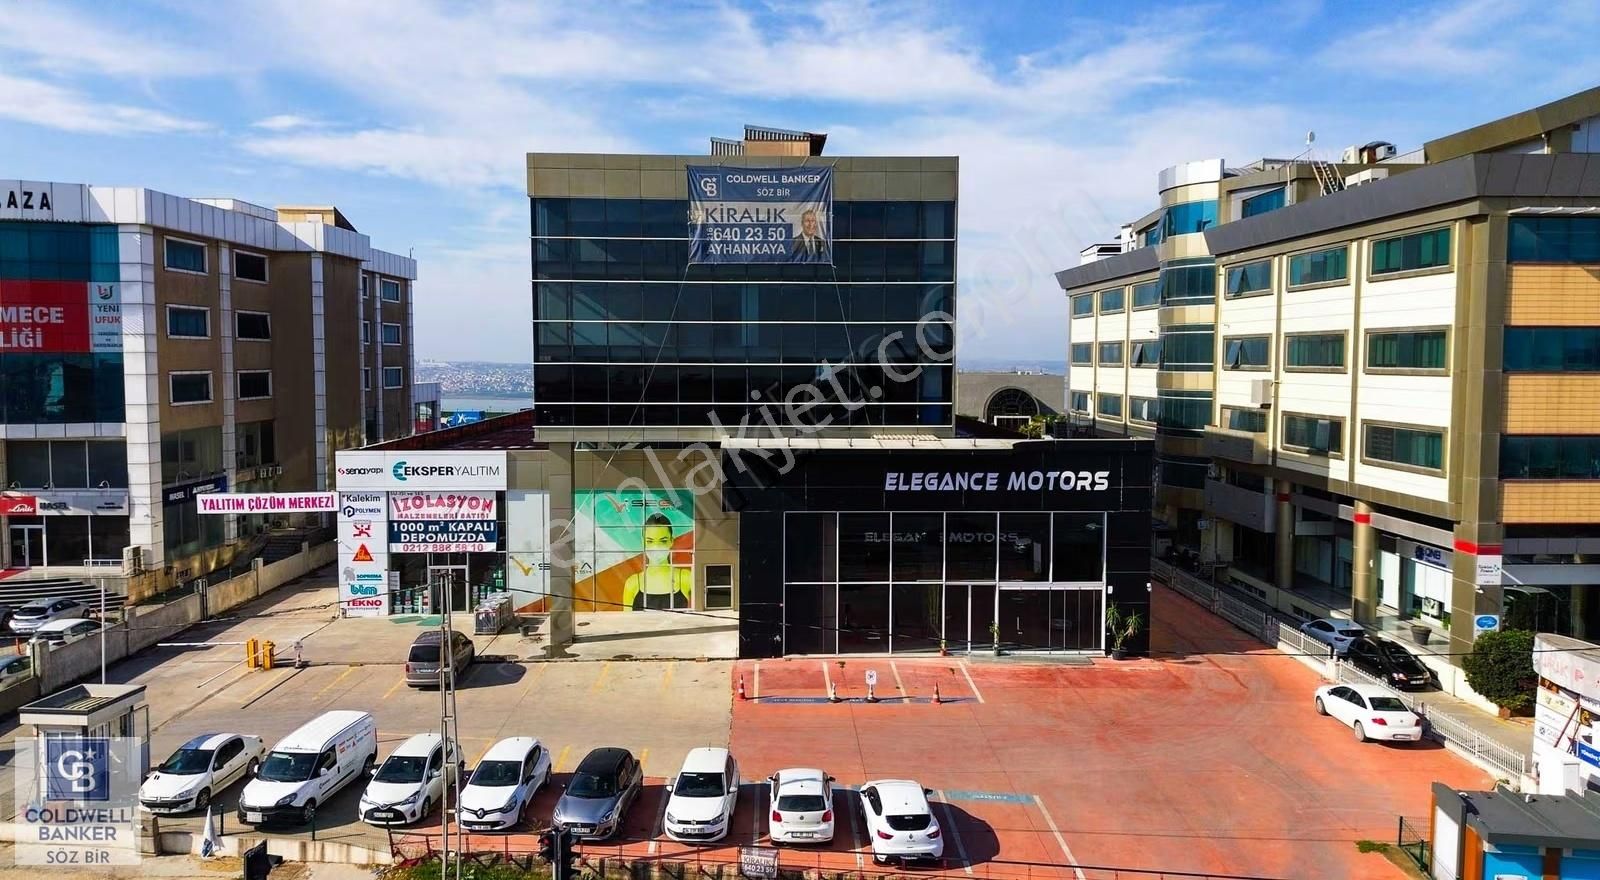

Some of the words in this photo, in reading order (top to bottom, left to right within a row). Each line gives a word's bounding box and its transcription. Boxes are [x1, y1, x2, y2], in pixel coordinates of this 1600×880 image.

[726, 175, 779, 184] COLDWELL
[781, 174, 821, 184] BANKER
[776, 187, 791, 197] BİR
[0, 190, 51, 210] AZA
[704, 203, 787, 223] KİRALIK
[713, 227, 741, 241] 640
[744, 227, 763, 241] 23
[767, 227, 786, 241] 50
[95, 316, 121, 324] UFUK
[885, 472, 999, 491] ELEGANCE
[1007, 471, 1110, 491] MOTORS
[201, 498, 246, 511] YALITIM
[249, 496, 286, 513] ÇÖZÜM
[288, 494, 335, 510] MERKEZİ
[346, 494, 381, 503] Kalekim
[392, 521, 424, 533] 1000
[448, 521, 494, 532] KAPALI
[400, 532, 487, 543] DEPOMUZDA
[949, 532, 1018, 543] MOTORS
[402, 543, 429, 552] 0212
[471, 543, 484, 552] 10
[350, 584, 378, 595] btm
